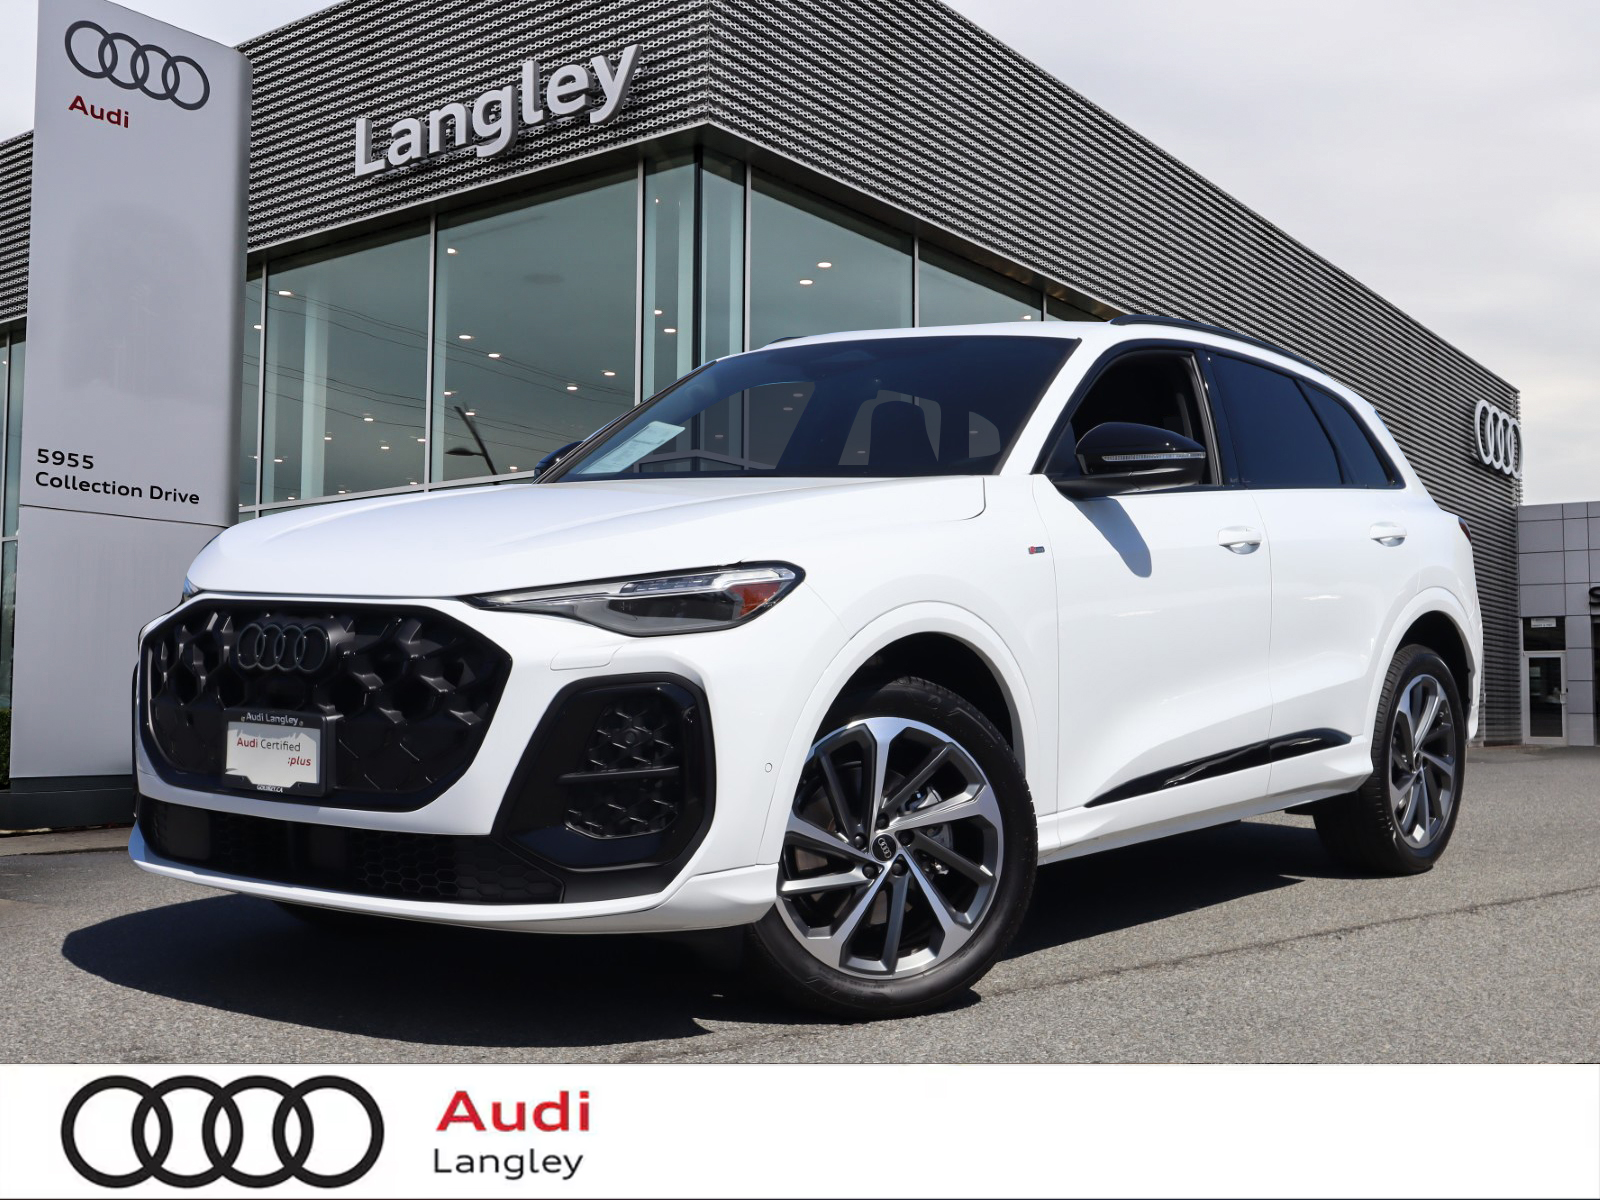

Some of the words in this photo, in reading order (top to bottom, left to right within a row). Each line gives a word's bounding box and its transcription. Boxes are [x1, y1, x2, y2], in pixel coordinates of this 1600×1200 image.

[68, 95, 129, 129] Audi
[355, 44, 643, 177] Langley
[36, 448, 94, 470] 5955
[35, 472, 143, 498] Collection
[149, 485, 200, 505] Drive
[246, 712, 264, 721] Audi
[265, 713, 298, 725] Langley
[237, 737, 258, 748] Audi
[260, 739, 301, 752] Certified
[287, 756, 311, 766] :plus
